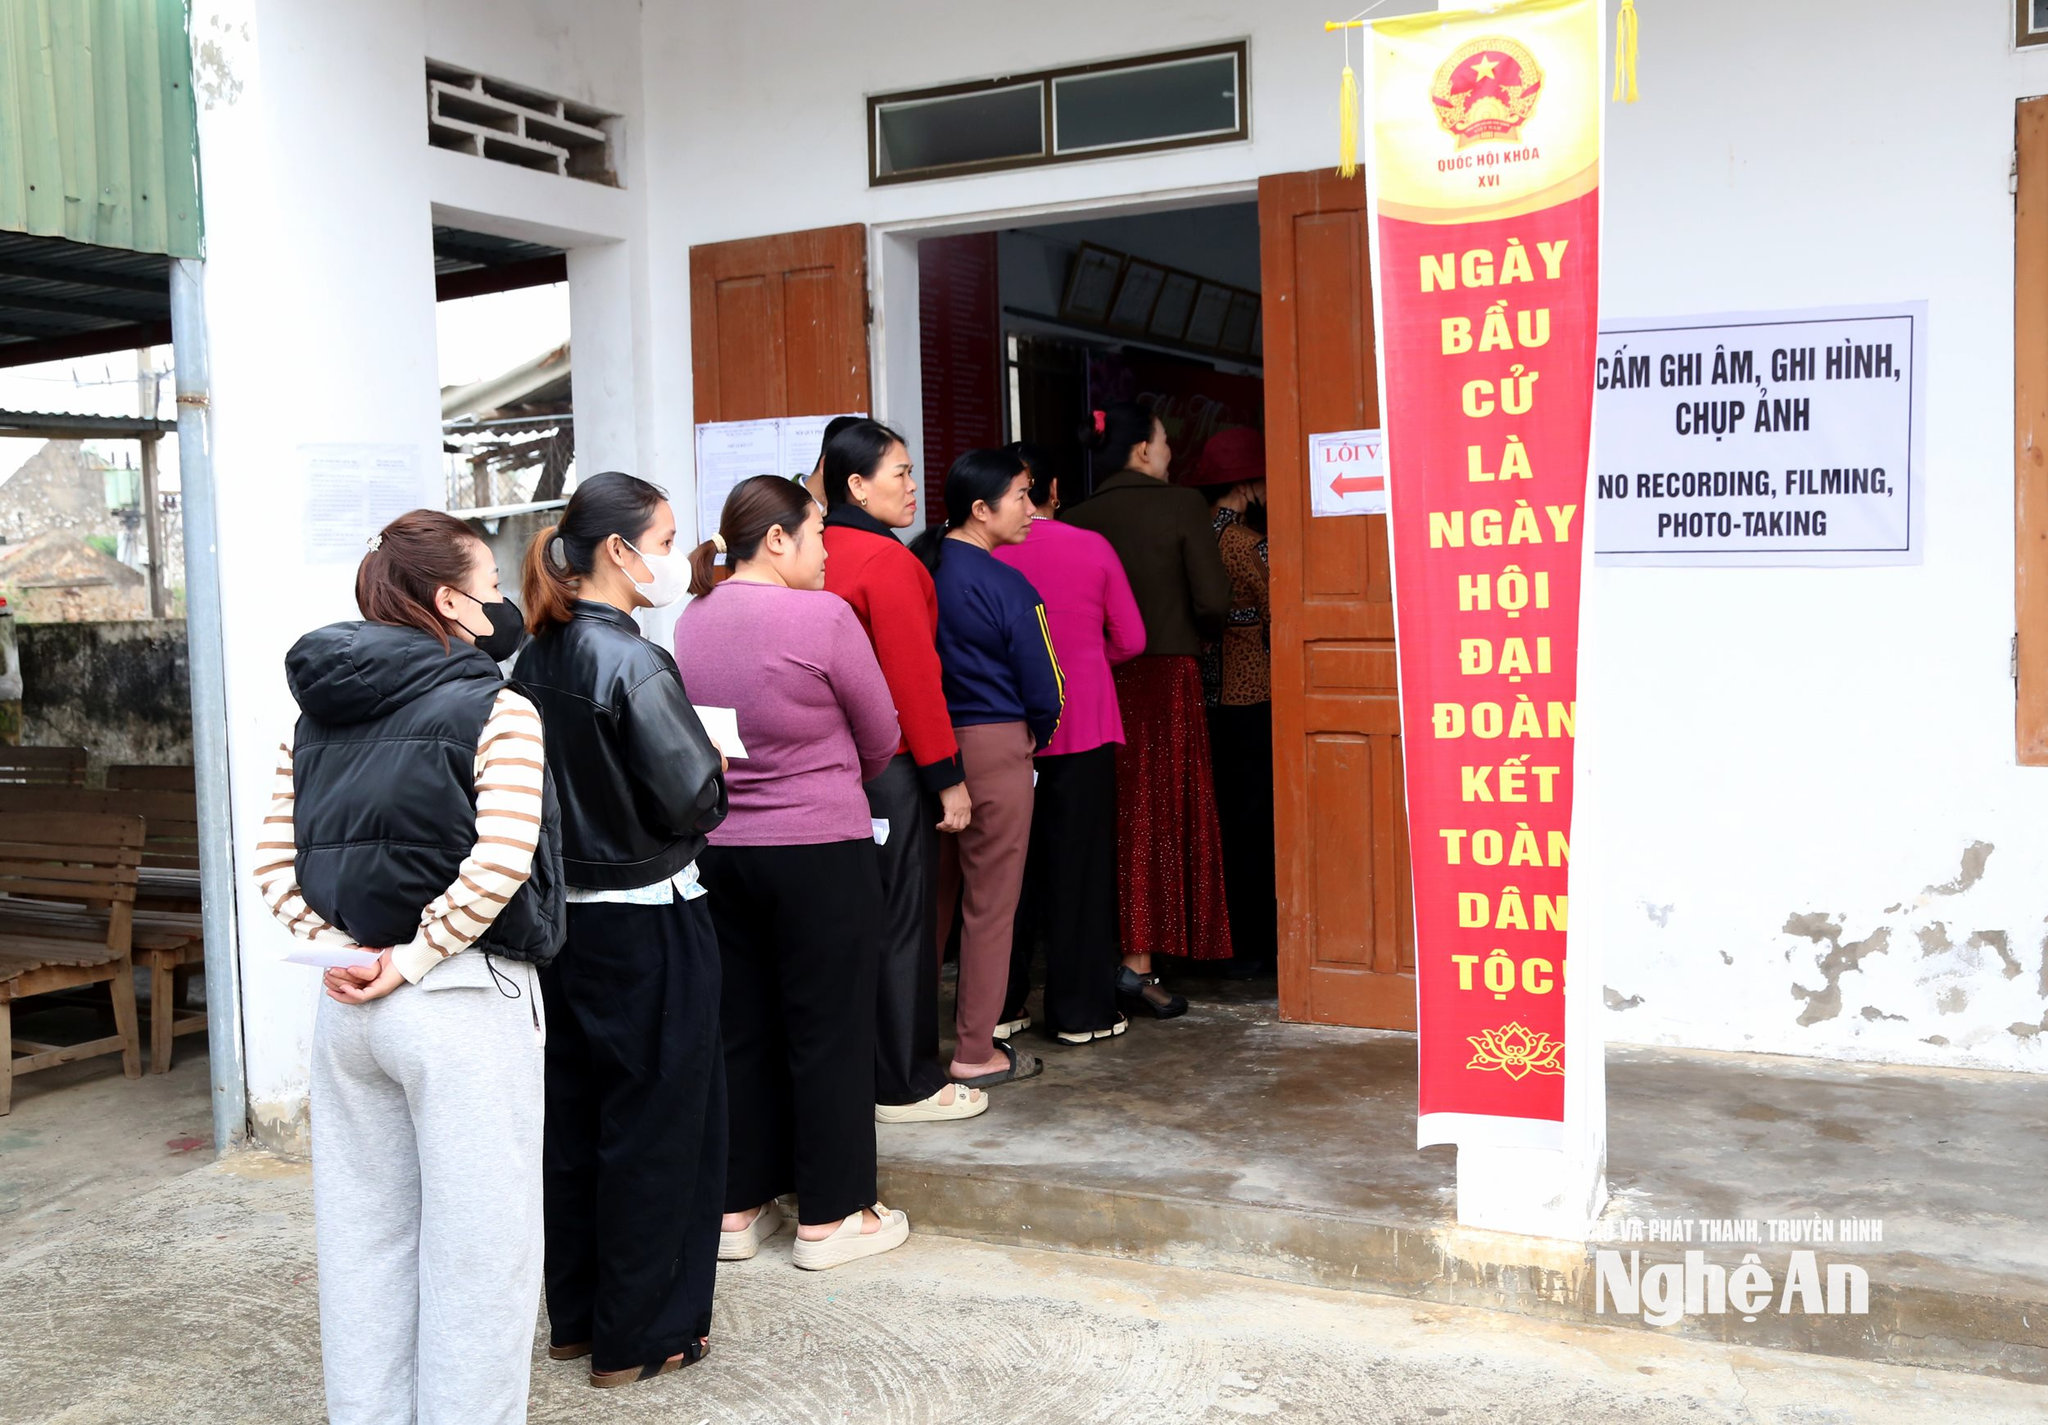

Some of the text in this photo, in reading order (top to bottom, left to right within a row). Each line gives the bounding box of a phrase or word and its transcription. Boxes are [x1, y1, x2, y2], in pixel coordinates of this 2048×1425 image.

[1438, 146, 1539, 172] QUỐC HỘI KHÓA
[1478, 174, 1500, 188] XVI
[1420, 237, 1569, 293] NGÀY
[1441, 300, 1551, 355] BẦU
[1597, 338, 1900, 390] CẤM GHI ÂM, GHI HÌNH,
[1462, 364, 1539, 418] CỬ
[1675, 387, 1810, 442] CHỤP ẢNH
[1467, 434, 1534, 482] LÀ
[1598, 467, 1894, 499] NO RECORDING, FILMING,
[1429, 499, 1577, 548] NGÀY
[1658, 510, 1827, 537] PHOTO-TAKING
[1458, 564, 1549, 618] HỘI
[1459, 636, 1551, 682] ĐẠI
[1431, 694, 1576, 739] ĐOÀN
[1461, 754, 1560, 802] KẾT
[1439, 822, 1570, 867] TOÀN
[1458, 886, 1568, 931] DÂN
